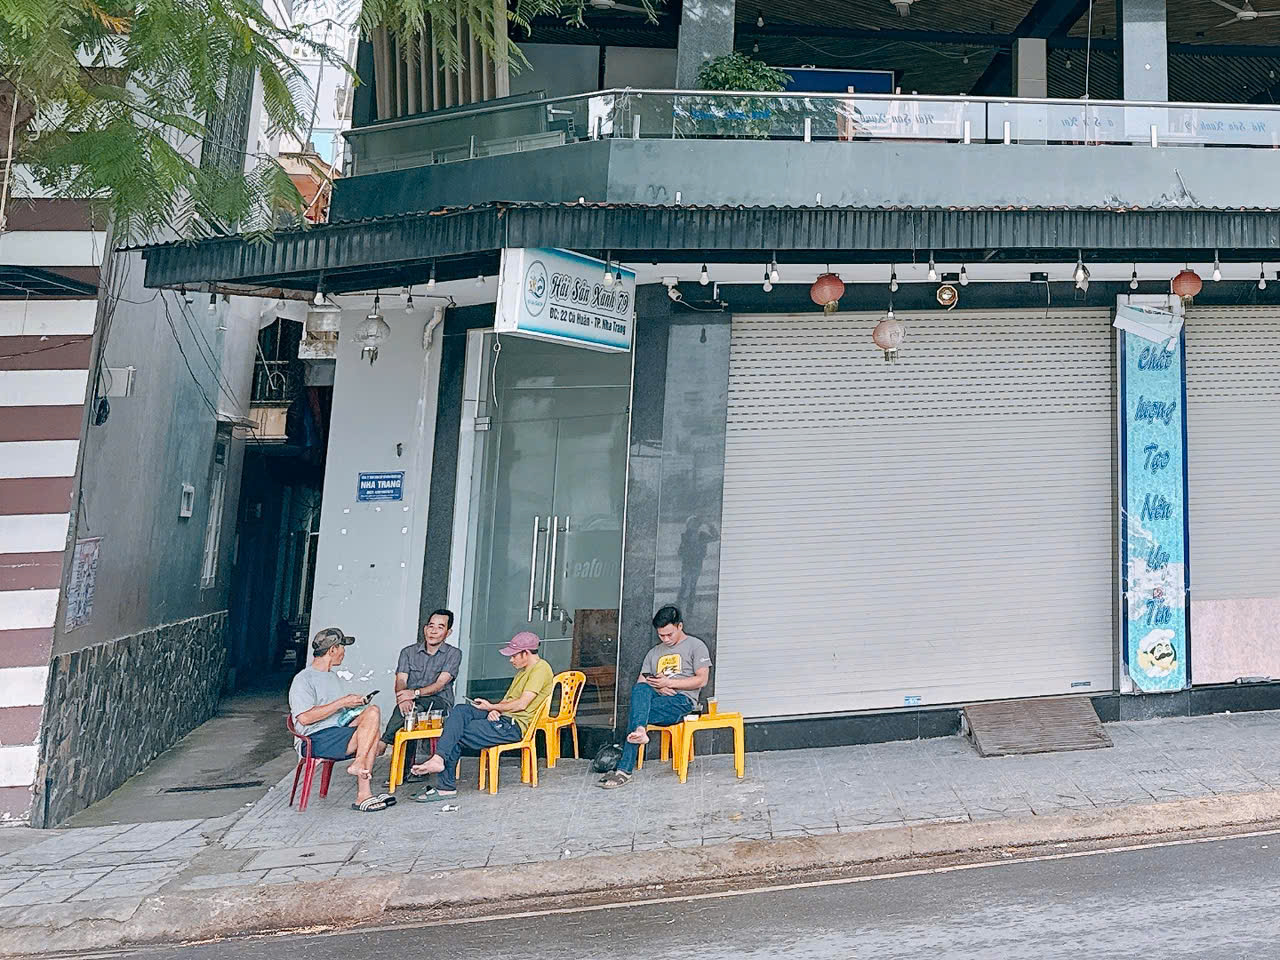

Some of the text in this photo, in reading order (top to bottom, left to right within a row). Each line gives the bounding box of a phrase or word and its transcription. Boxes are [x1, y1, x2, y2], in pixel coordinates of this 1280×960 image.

[549, 273, 629, 315] Hải Sản Xanh 79
[560, 310, 567, 321] 22
[602, 319, 612, 331] Nha
[613, 321, 626, 335] Trang
[1143, 442, 1171, 475] Tạo
[361, 480, 401, 489] NHA TRANG
[1140, 492, 1172, 521] Nên
